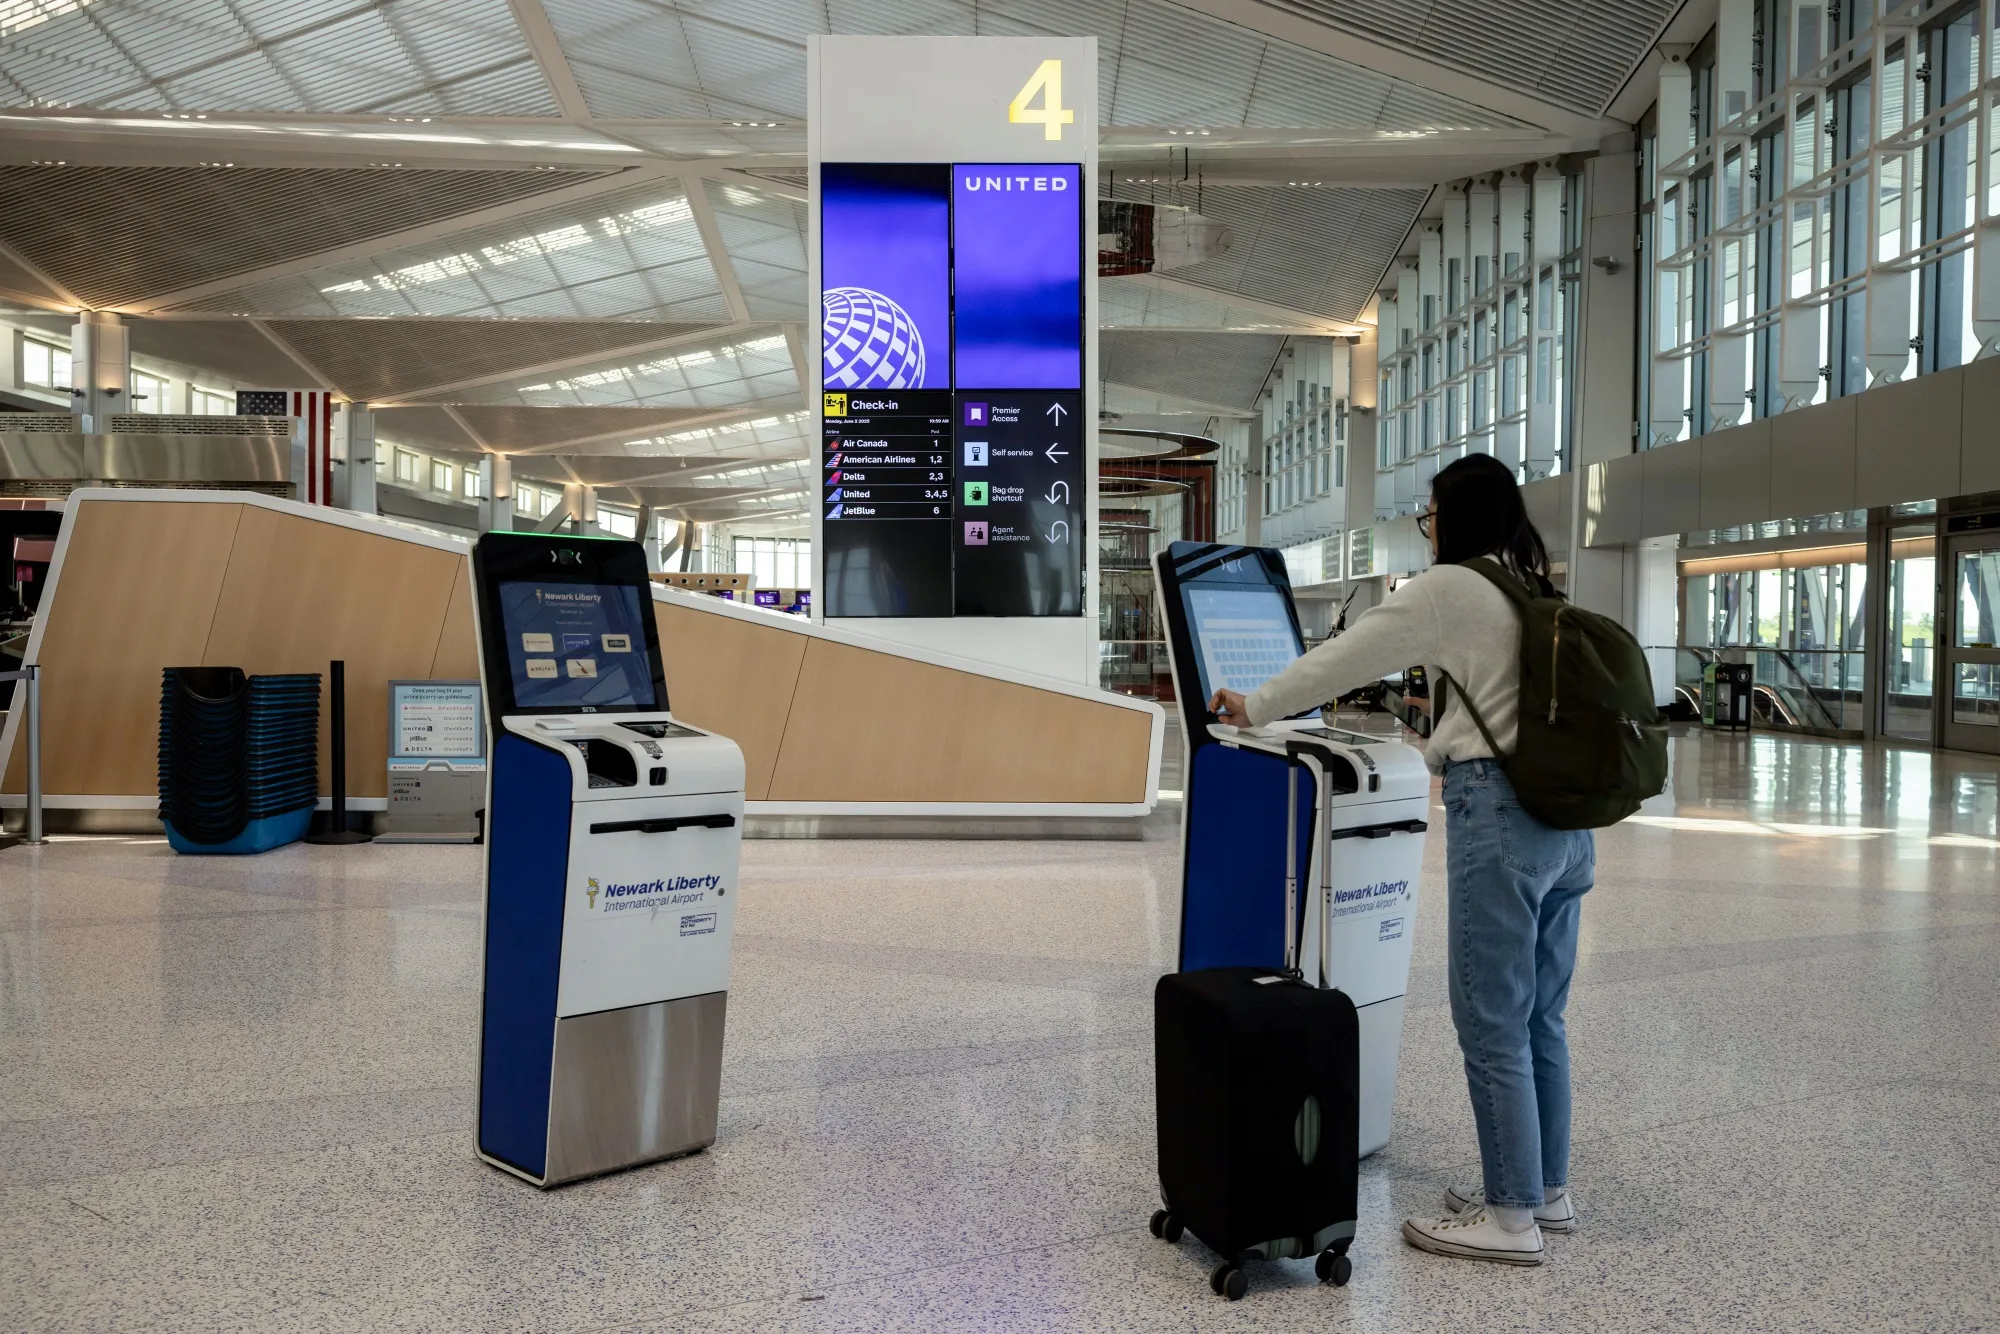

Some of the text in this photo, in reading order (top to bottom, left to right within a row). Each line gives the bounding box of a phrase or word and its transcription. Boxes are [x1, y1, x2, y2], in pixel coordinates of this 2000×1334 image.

[1008, 59, 1074, 141] 4
[965, 176, 1068, 192] UNITED
[851, 400, 899, 411] Check-in
[992, 406, 1021, 414] Premier
[843, 440, 888, 448] Air Canada
[933, 440, 939, 448] 1
[992, 448, 1034, 457] Self service
[843, 456, 916, 464] American Airlines
[929, 456, 943, 465] 1,2
[843, 472, 865, 481] Delta
[929, 472, 944, 482] 2,3
[843, 490, 870, 498] United
[925, 490, 948, 499] 3,4,5
[992, 486, 1024, 495] Bag drop
[992, 494, 1023, 502] shortcut
[843, 507, 876, 515] JetBlue
[933, 507, 940, 515] 6
[992, 526, 1014, 535] Agent
[992, 534, 1030, 542] assistance
[544, 592, 602, 603] Newark Liberty
[605, 874, 721, 898] Newark Liberty
[1333, 879, 1409, 904] Newark Liberty
[603, 891, 704, 913] International Airport
[1332, 897, 1397, 918] International Airport
[680, 916, 712, 925] AUTHORITY
